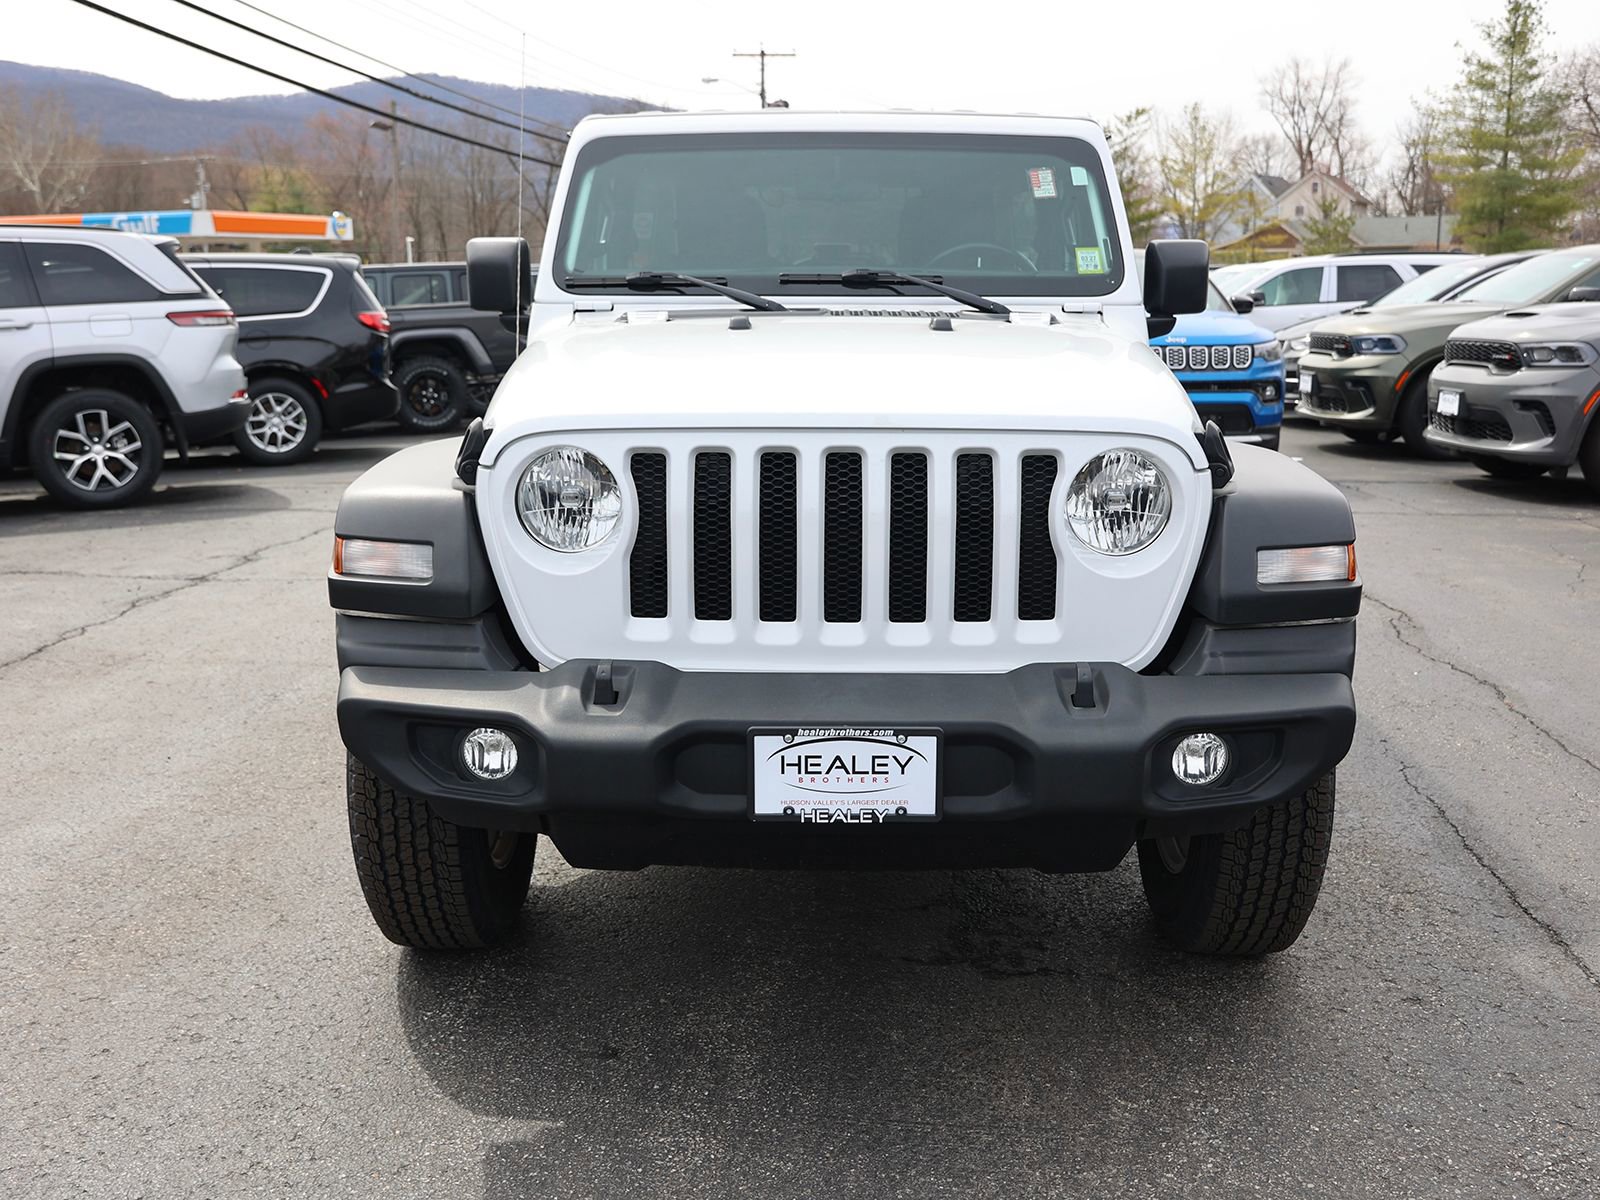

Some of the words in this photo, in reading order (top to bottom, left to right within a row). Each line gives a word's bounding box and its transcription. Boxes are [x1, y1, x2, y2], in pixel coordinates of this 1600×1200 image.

[797, 728, 894, 737] healeybrothers.com
[780, 755, 914, 775] HEALEY
[800, 808, 889, 823] HEALEY
